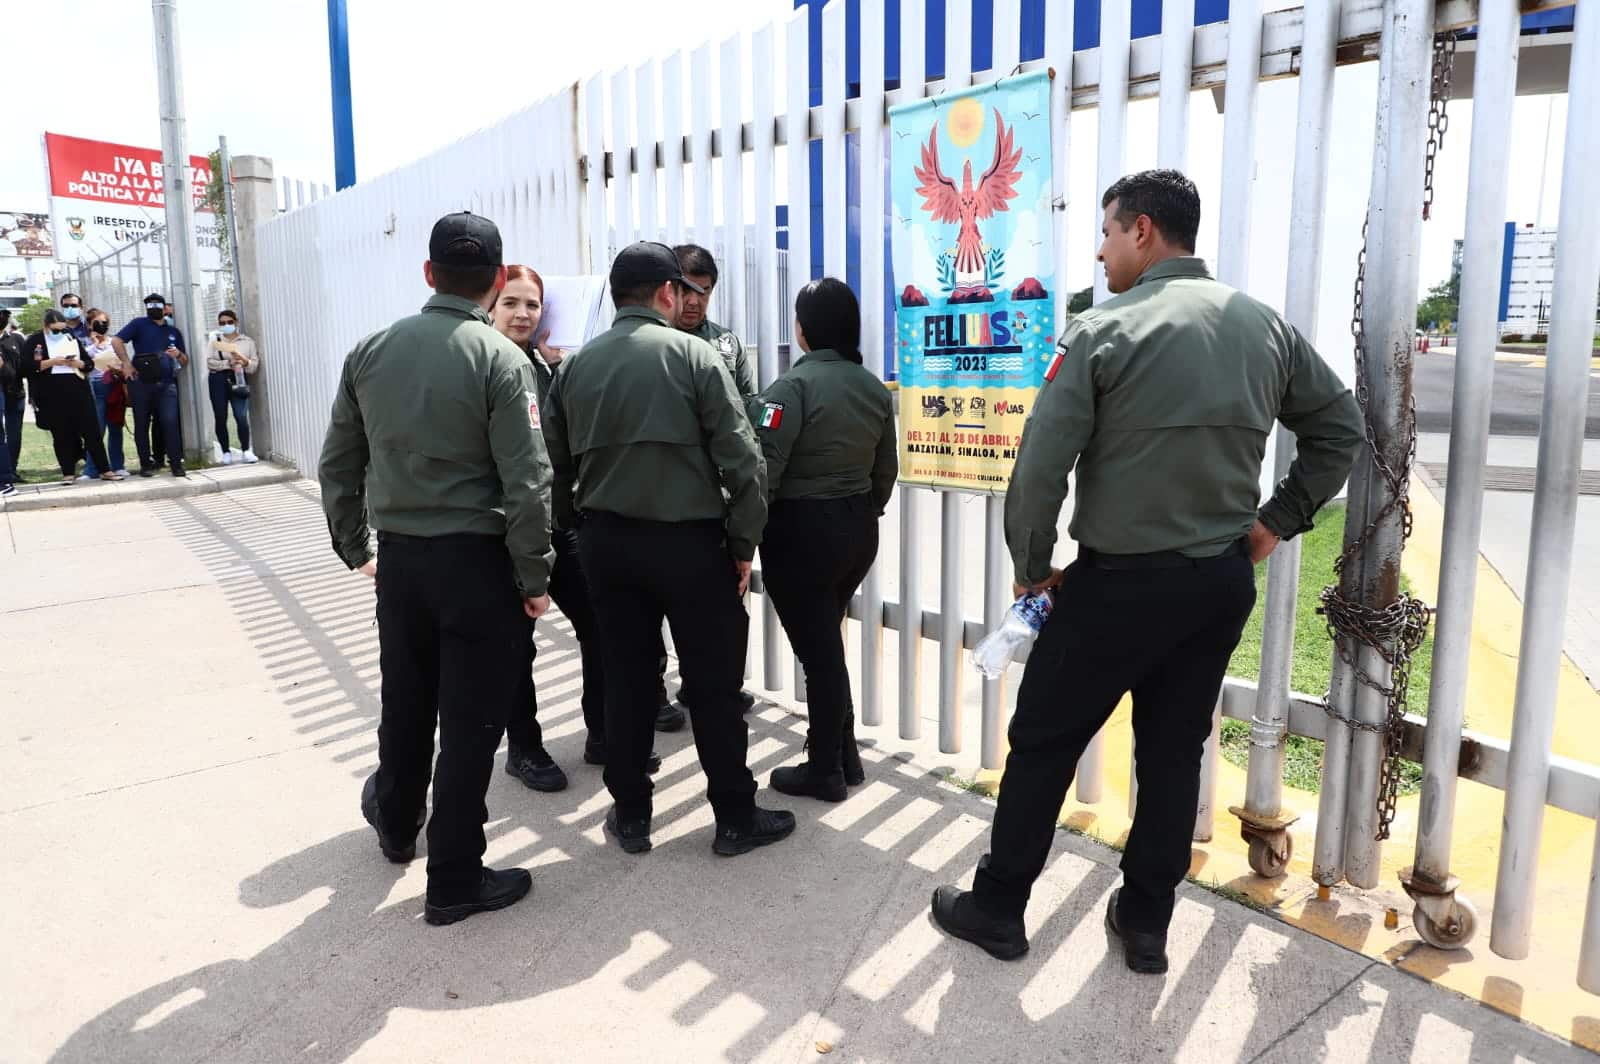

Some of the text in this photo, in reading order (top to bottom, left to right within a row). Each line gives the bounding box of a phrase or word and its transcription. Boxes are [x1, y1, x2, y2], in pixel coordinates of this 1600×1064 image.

[81, 170, 117, 185] ALTO
[120, 176, 131, 187] A
[134, 177, 152, 189] LA
[135, 191, 145, 201] Y
[924, 311, 1011, 347] FELIUAS
[955, 356, 987, 372] 2023
[922, 396, 945, 408] UAS
[907, 431, 922, 441] DEL
[926, 432, 936, 442] 21
[940, 432, 950, 443] AL
[954, 432, 965, 443] 28
[968, 433, 979, 444] DE
[982, 434, 1011, 446] ABRIL
[958, 447, 999, 459] SINALOA,
